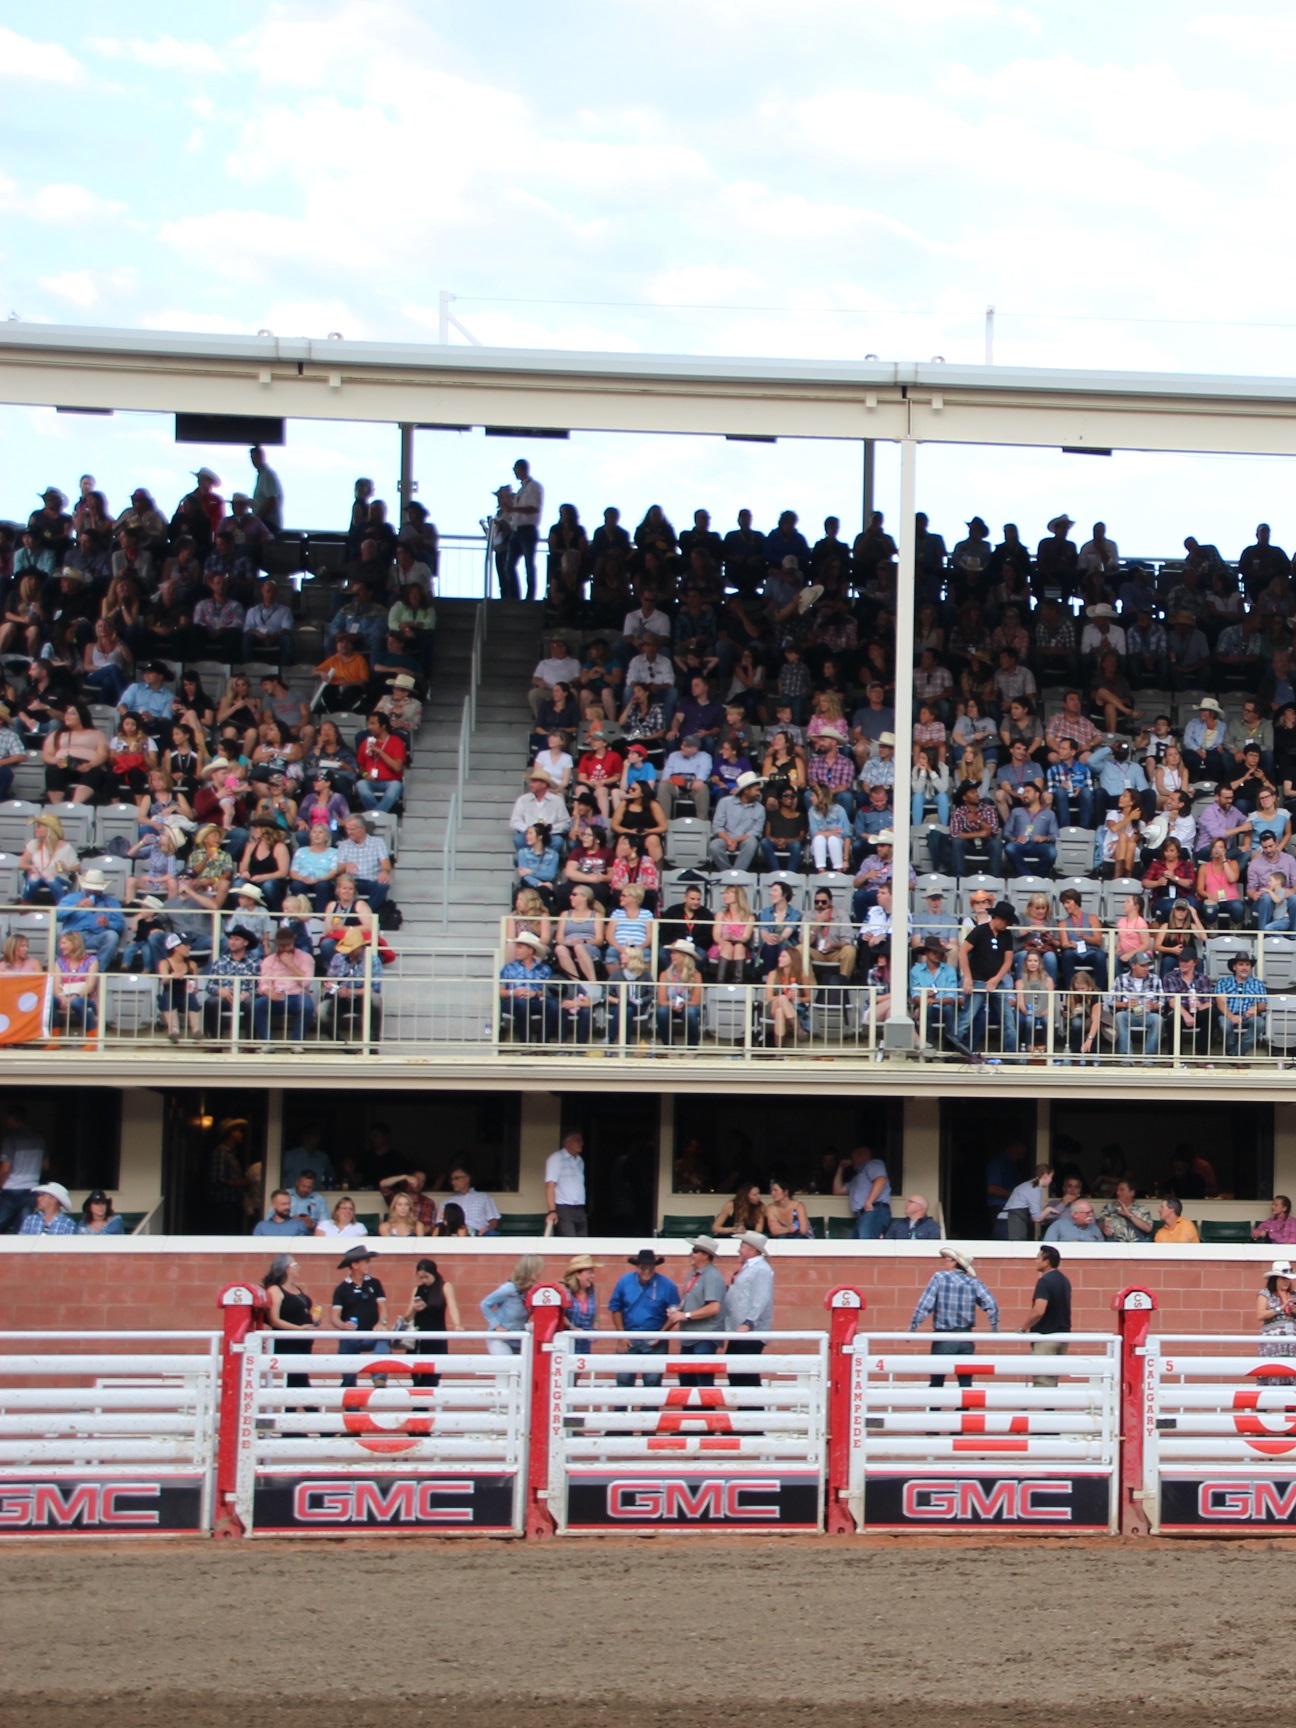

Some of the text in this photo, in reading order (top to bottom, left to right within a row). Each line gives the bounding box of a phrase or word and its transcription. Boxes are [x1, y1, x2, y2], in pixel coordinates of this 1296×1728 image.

[269, 1358, 279, 1370] 2
[577, 1358, 586, 1370] 3
[876, 1359, 884, 1371] 4
[1166, 1360, 1173, 1372] 5
[242, 1356, 254, 1449] STAMPEDE
[552, 1355, 562, 1436] CALGARY
[853, 1357, 863, 1449] STAMPEDE
[1146, 1358, 1155, 1437] CALGARY
[294, 1481, 475, 1522] GMC
[607, 1480, 781, 1519] GMC
[903, 1480, 1072, 1520] GMC
